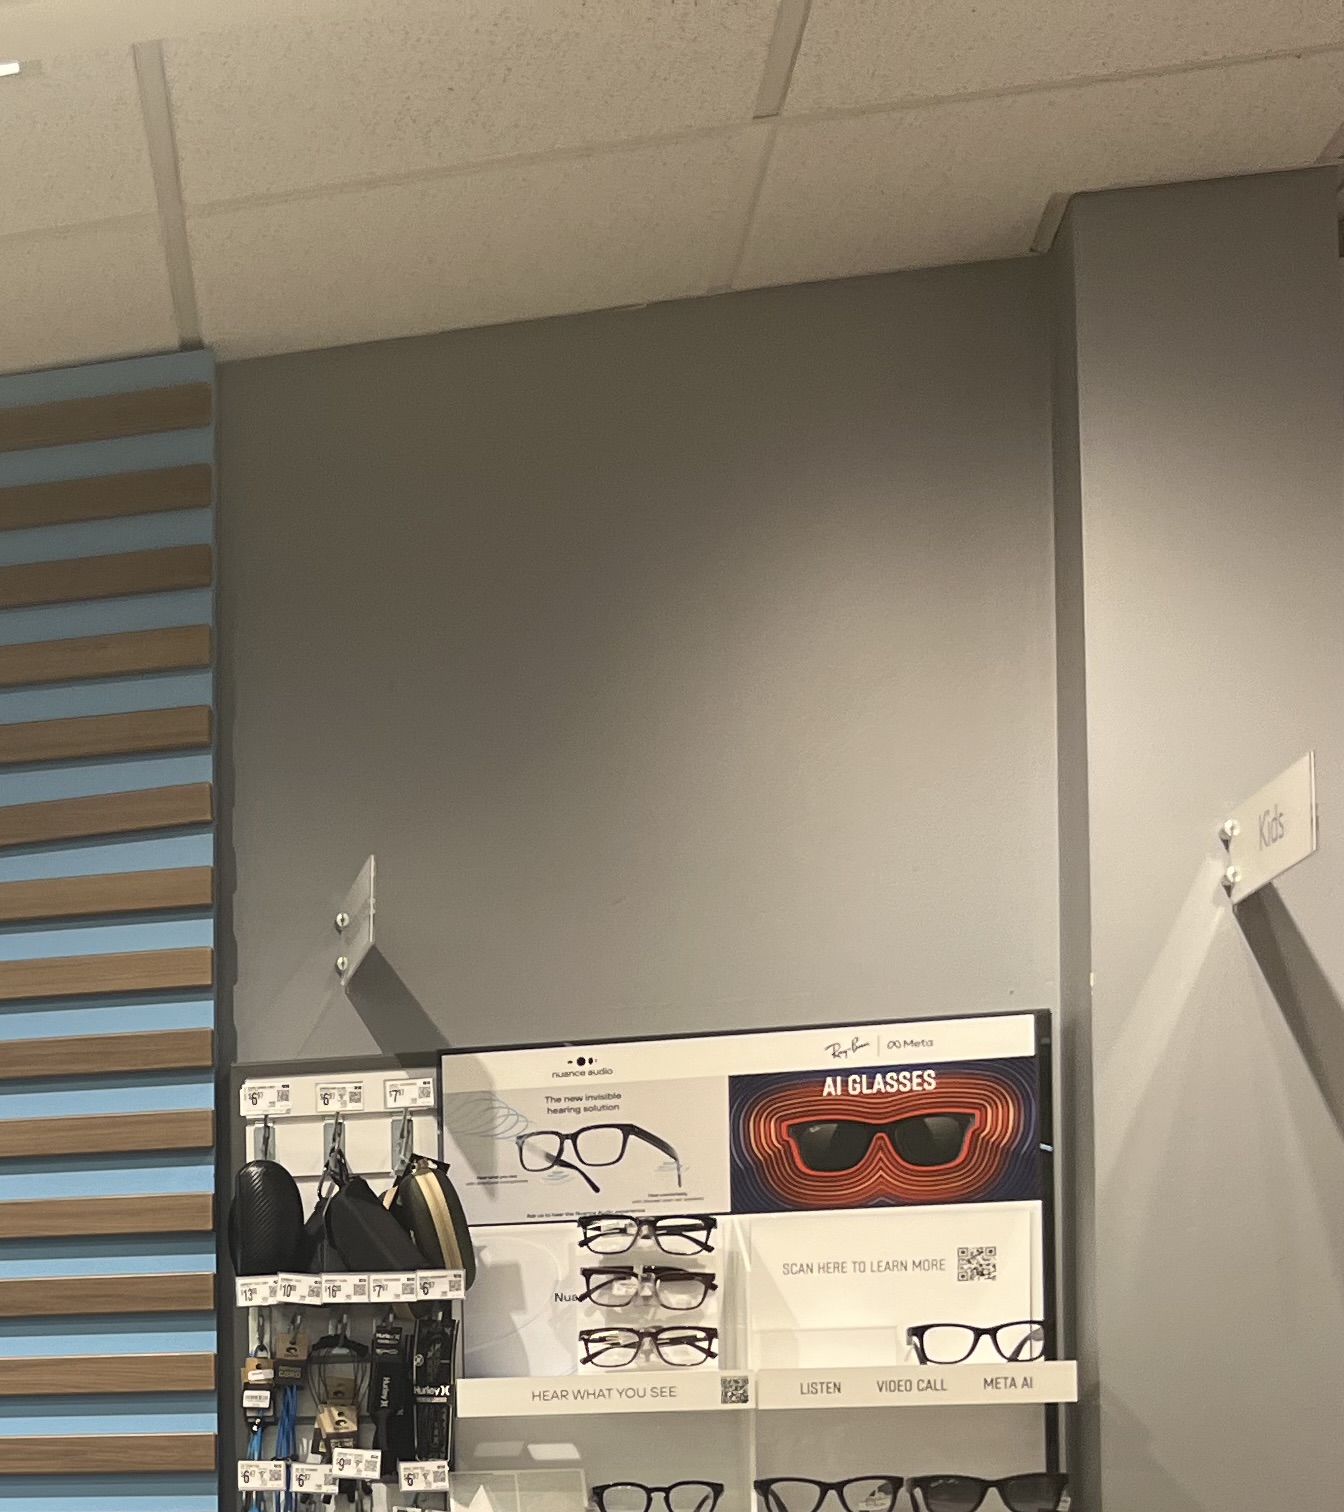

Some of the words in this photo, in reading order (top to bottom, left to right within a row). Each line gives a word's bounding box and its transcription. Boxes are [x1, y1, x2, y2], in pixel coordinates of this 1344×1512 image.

[1259, 804, 1284, 850] Kids
[552, 1070, 585, 1078] nuance
[588, 1068, 613, 1076] audio
[823, 1076, 842, 1096] AI
[848, 1070, 936, 1095] GLASSES
[585, 1092, 622, 1100] invisible
[547, 1106, 581, 1114] hearing
[584, 1104, 619, 1112] solution
[783, 1263, 813, 1275] SCAN
[818, 1262, 848, 1274] HERE
[853, 1261, 866, 1273] TO
[870, 1260, 908, 1273] LEARN
[912, 1259, 946, 1271] MORE
[414, 1385, 440, 1396] Hurley
[532, 1390, 569, 1401] HEAR
[572, 1389, 613, 1400] WHAT
[616, 1387, 646, 1399] YOU
[651, 1386, 677, 1397] SEE
[800, 1382, 842, 1395] LISTEN
[876, 1380, 912, 1393] VIDEO
[917, 1378, 948, 1392] CALL
[984, 1377, 1017, 1390] META
[1022, 1377, 1034, 1390] AI
